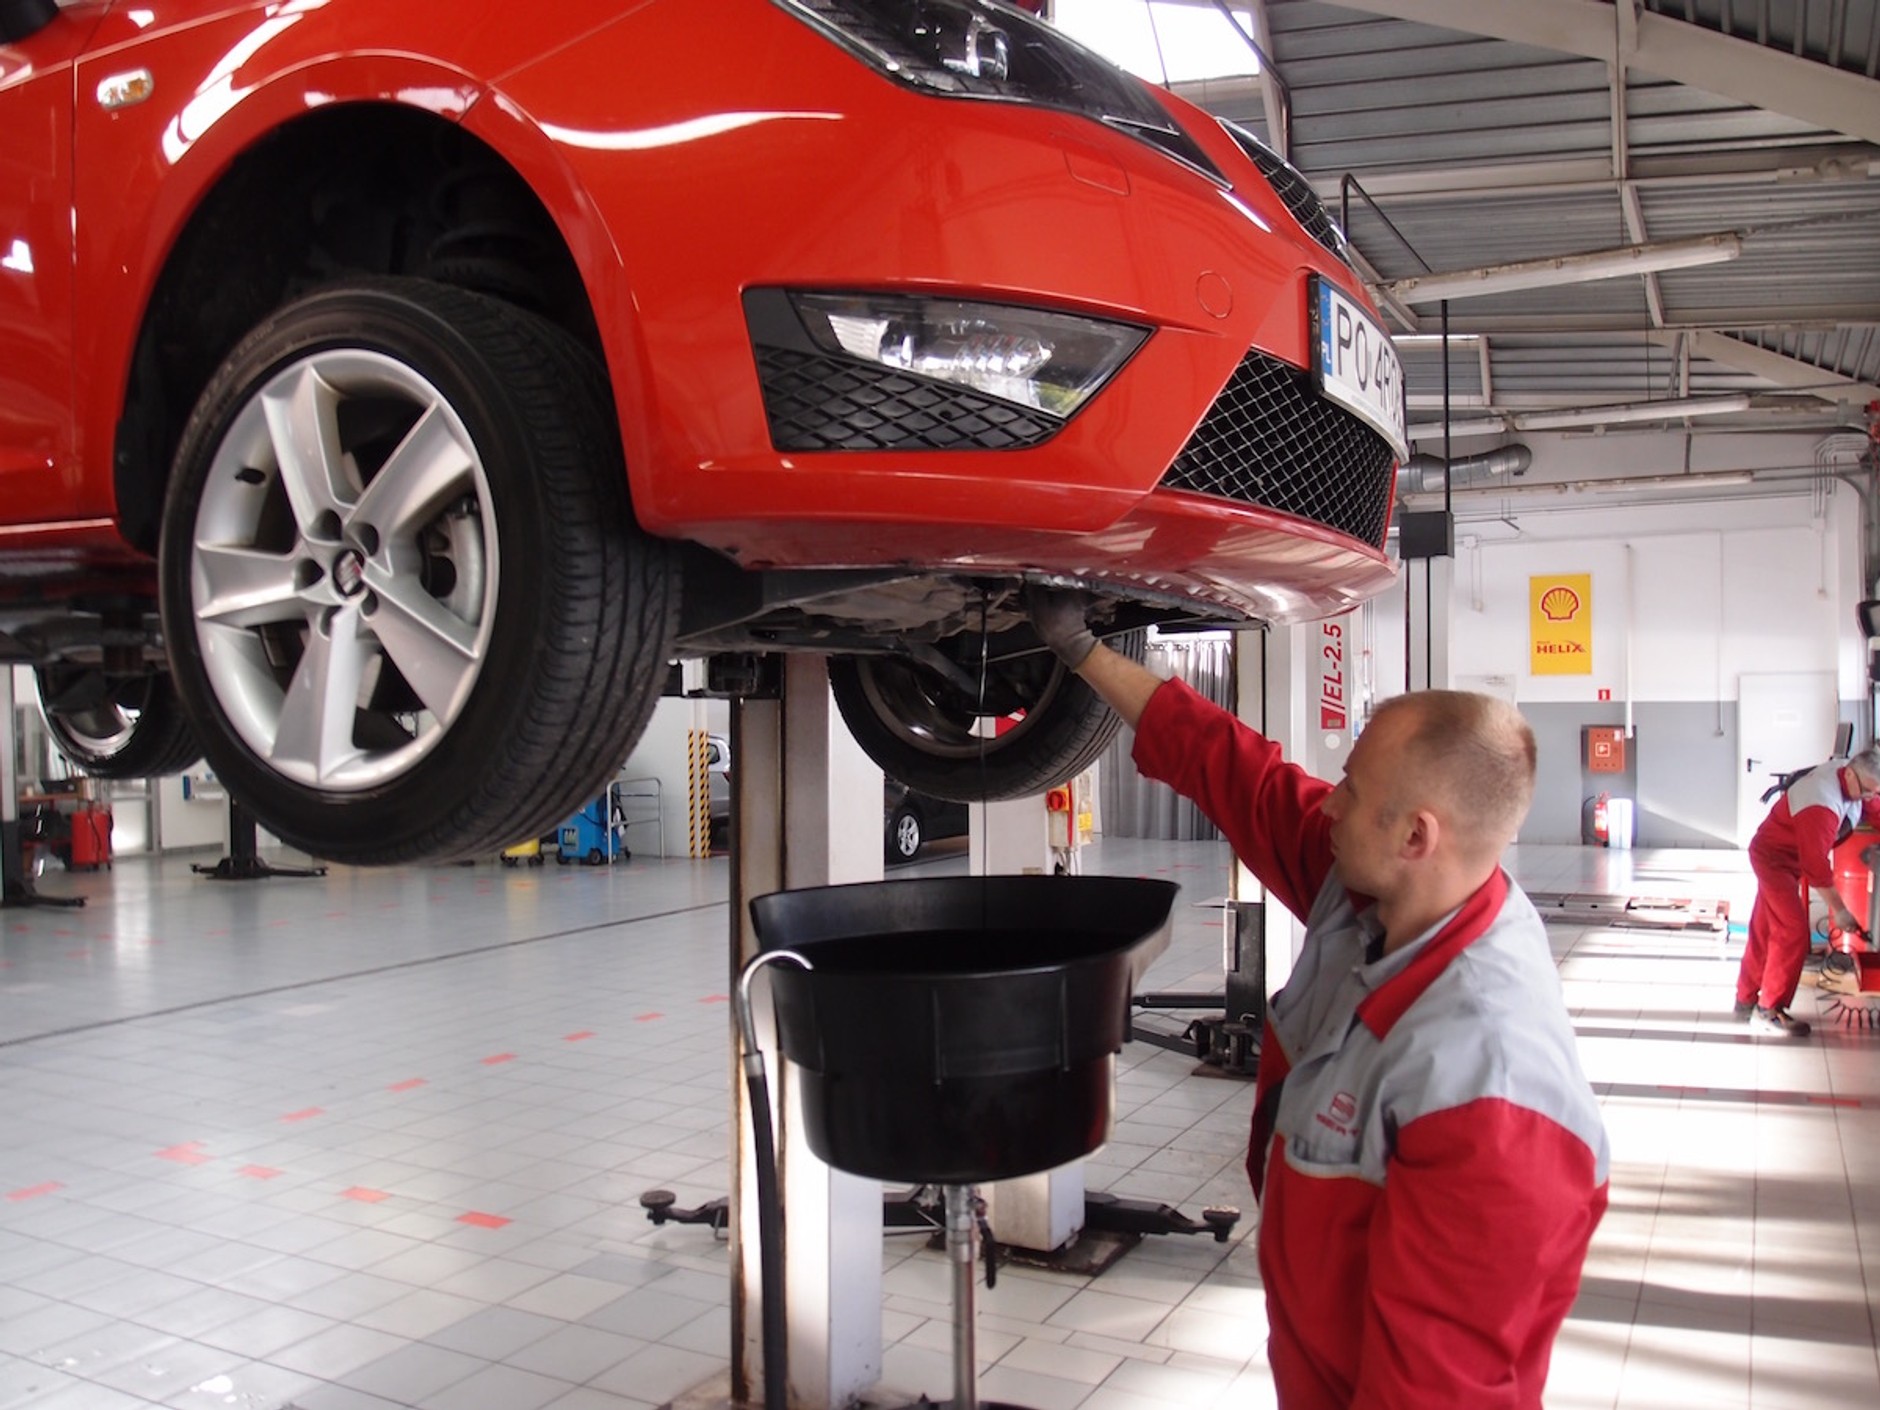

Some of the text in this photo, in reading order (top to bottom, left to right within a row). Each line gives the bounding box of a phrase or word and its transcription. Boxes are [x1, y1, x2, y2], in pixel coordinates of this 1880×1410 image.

[1321, 340, 1332, 364] PL
[1336, 302, 1368, 392] PO
[1536, 642, 1585, 654] HELIX
